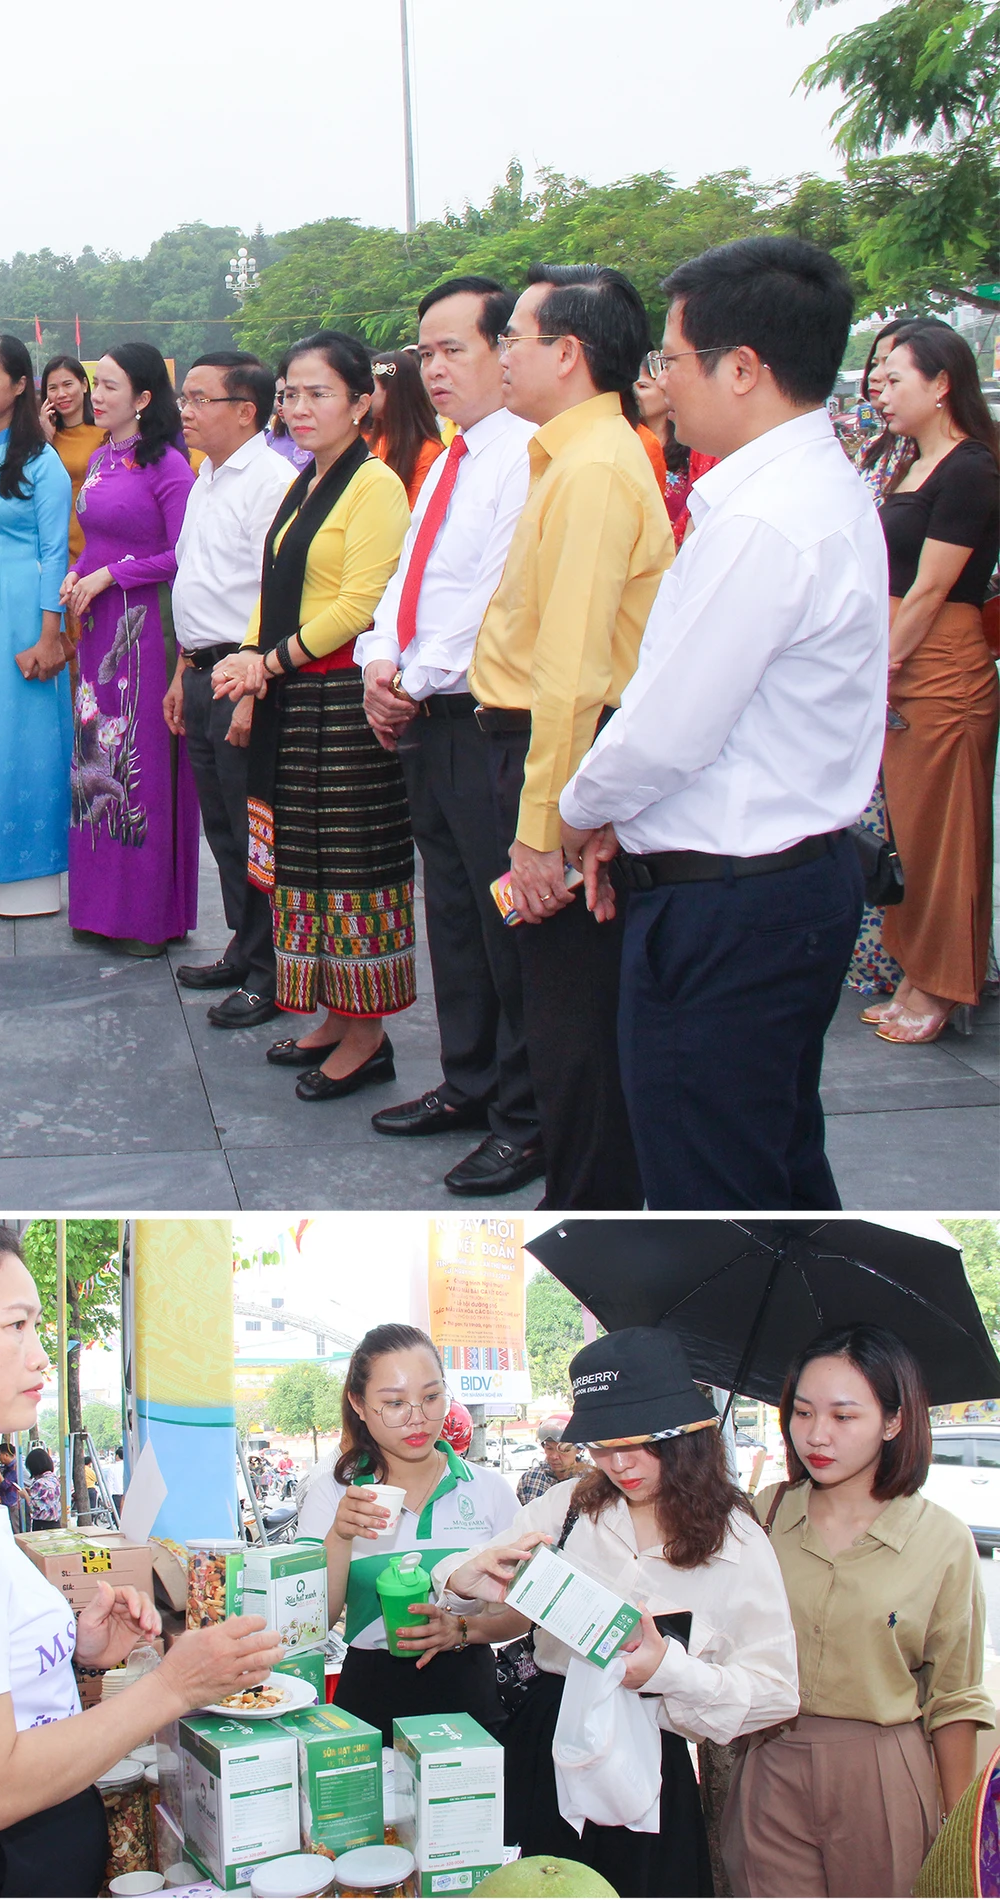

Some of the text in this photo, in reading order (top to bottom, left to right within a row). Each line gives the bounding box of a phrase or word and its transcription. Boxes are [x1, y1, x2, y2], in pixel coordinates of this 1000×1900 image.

[458, 1236, 515, 1260] KẾT ĐOÀN
[461, 1376, 492, 1390] BIDV
[572, 1370, 620, 1388] URBERRY
